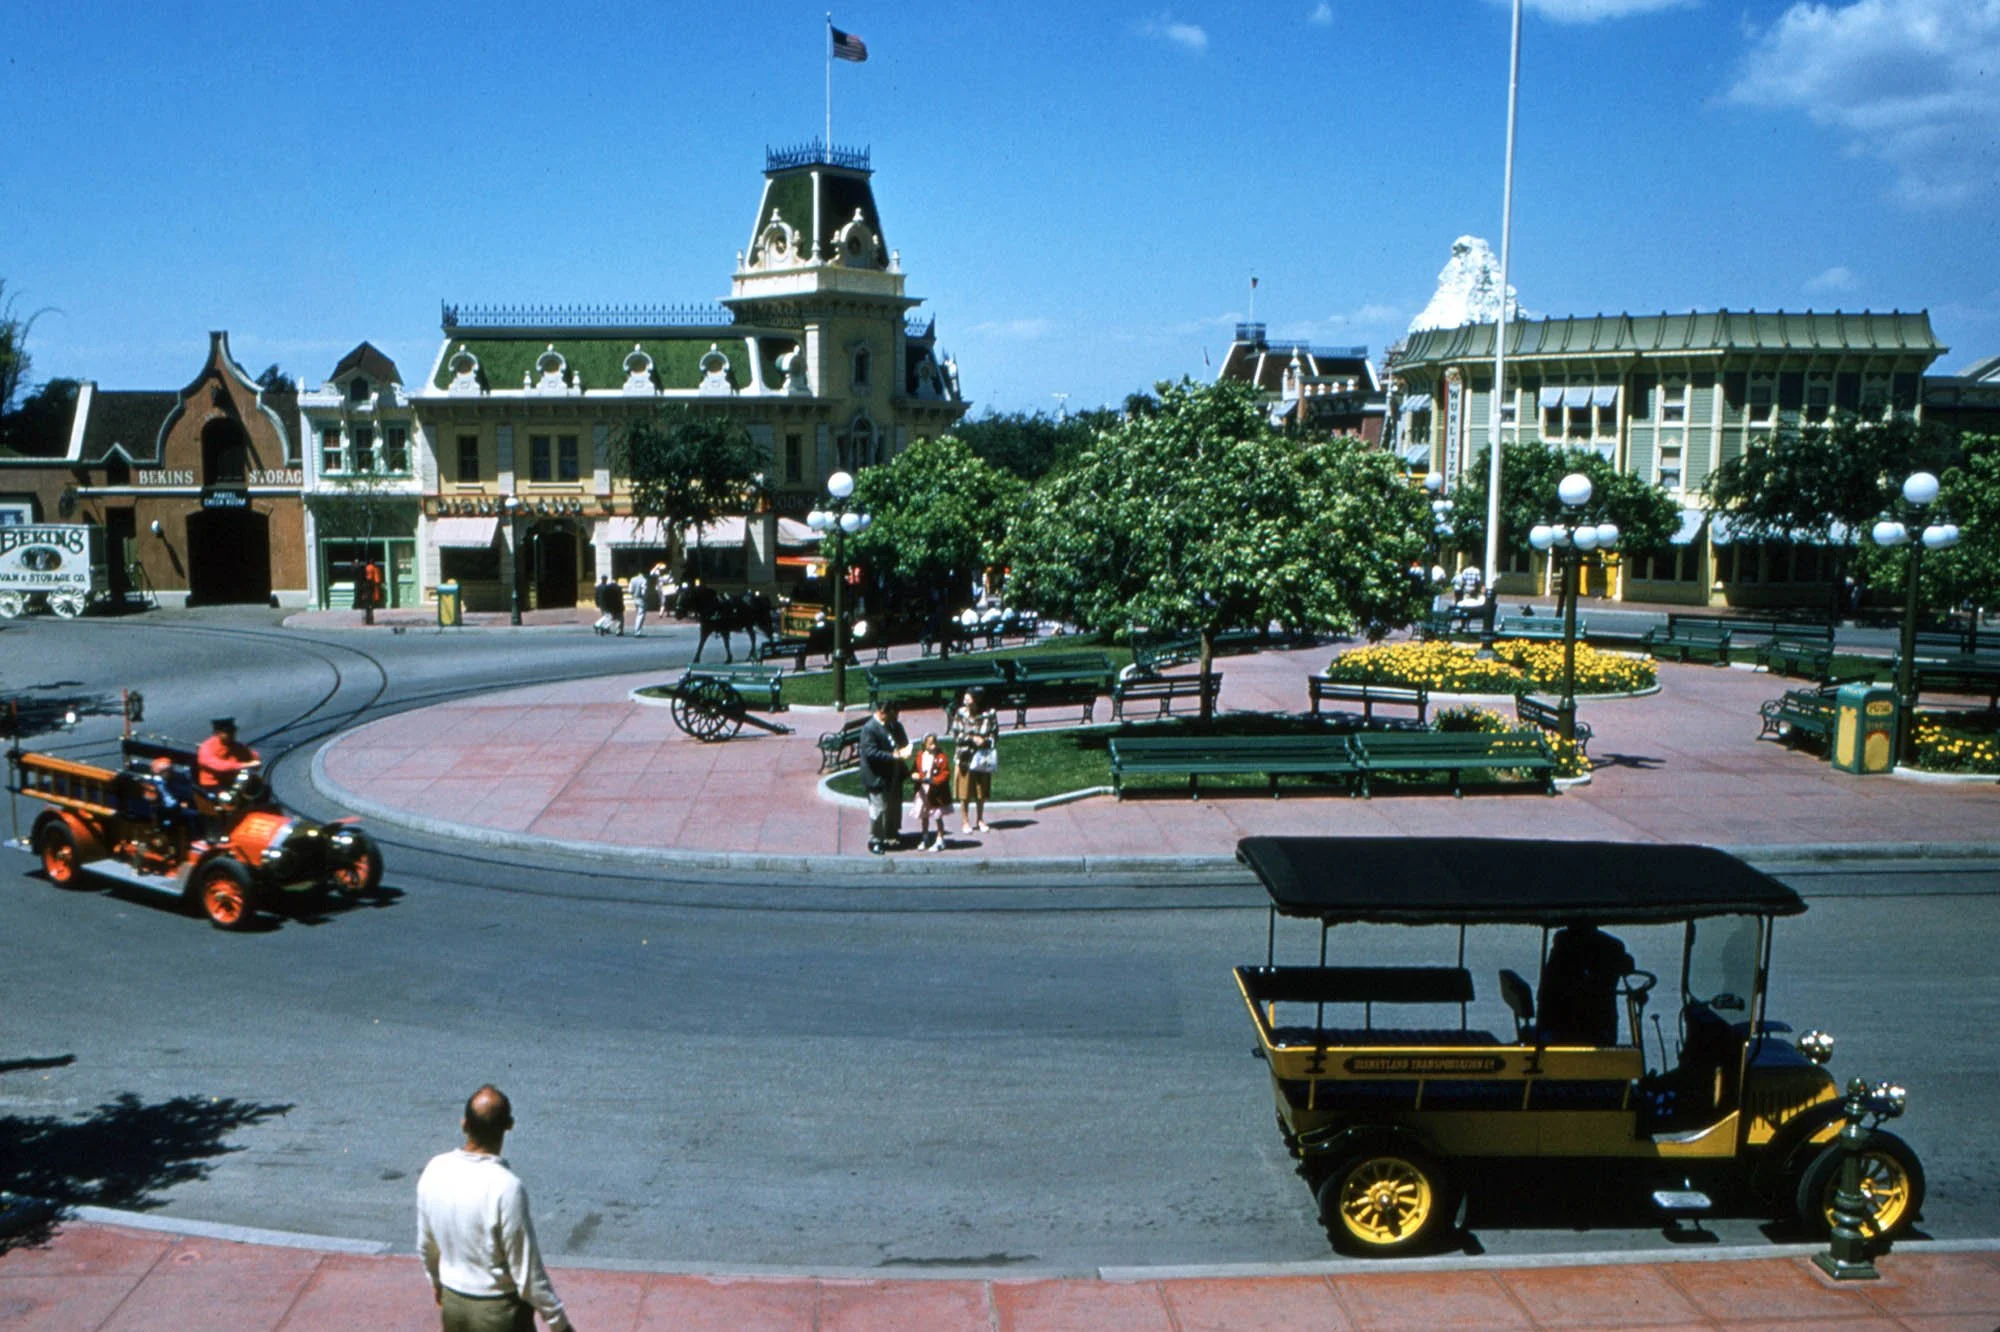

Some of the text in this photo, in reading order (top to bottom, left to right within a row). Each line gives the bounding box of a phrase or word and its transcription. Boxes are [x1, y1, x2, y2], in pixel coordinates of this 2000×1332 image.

[139, 469, 302, 485] BEKINS STORAG
[0, 528, 84, 554] BEKINS
[29, 573, 70, 582] STORAGE
